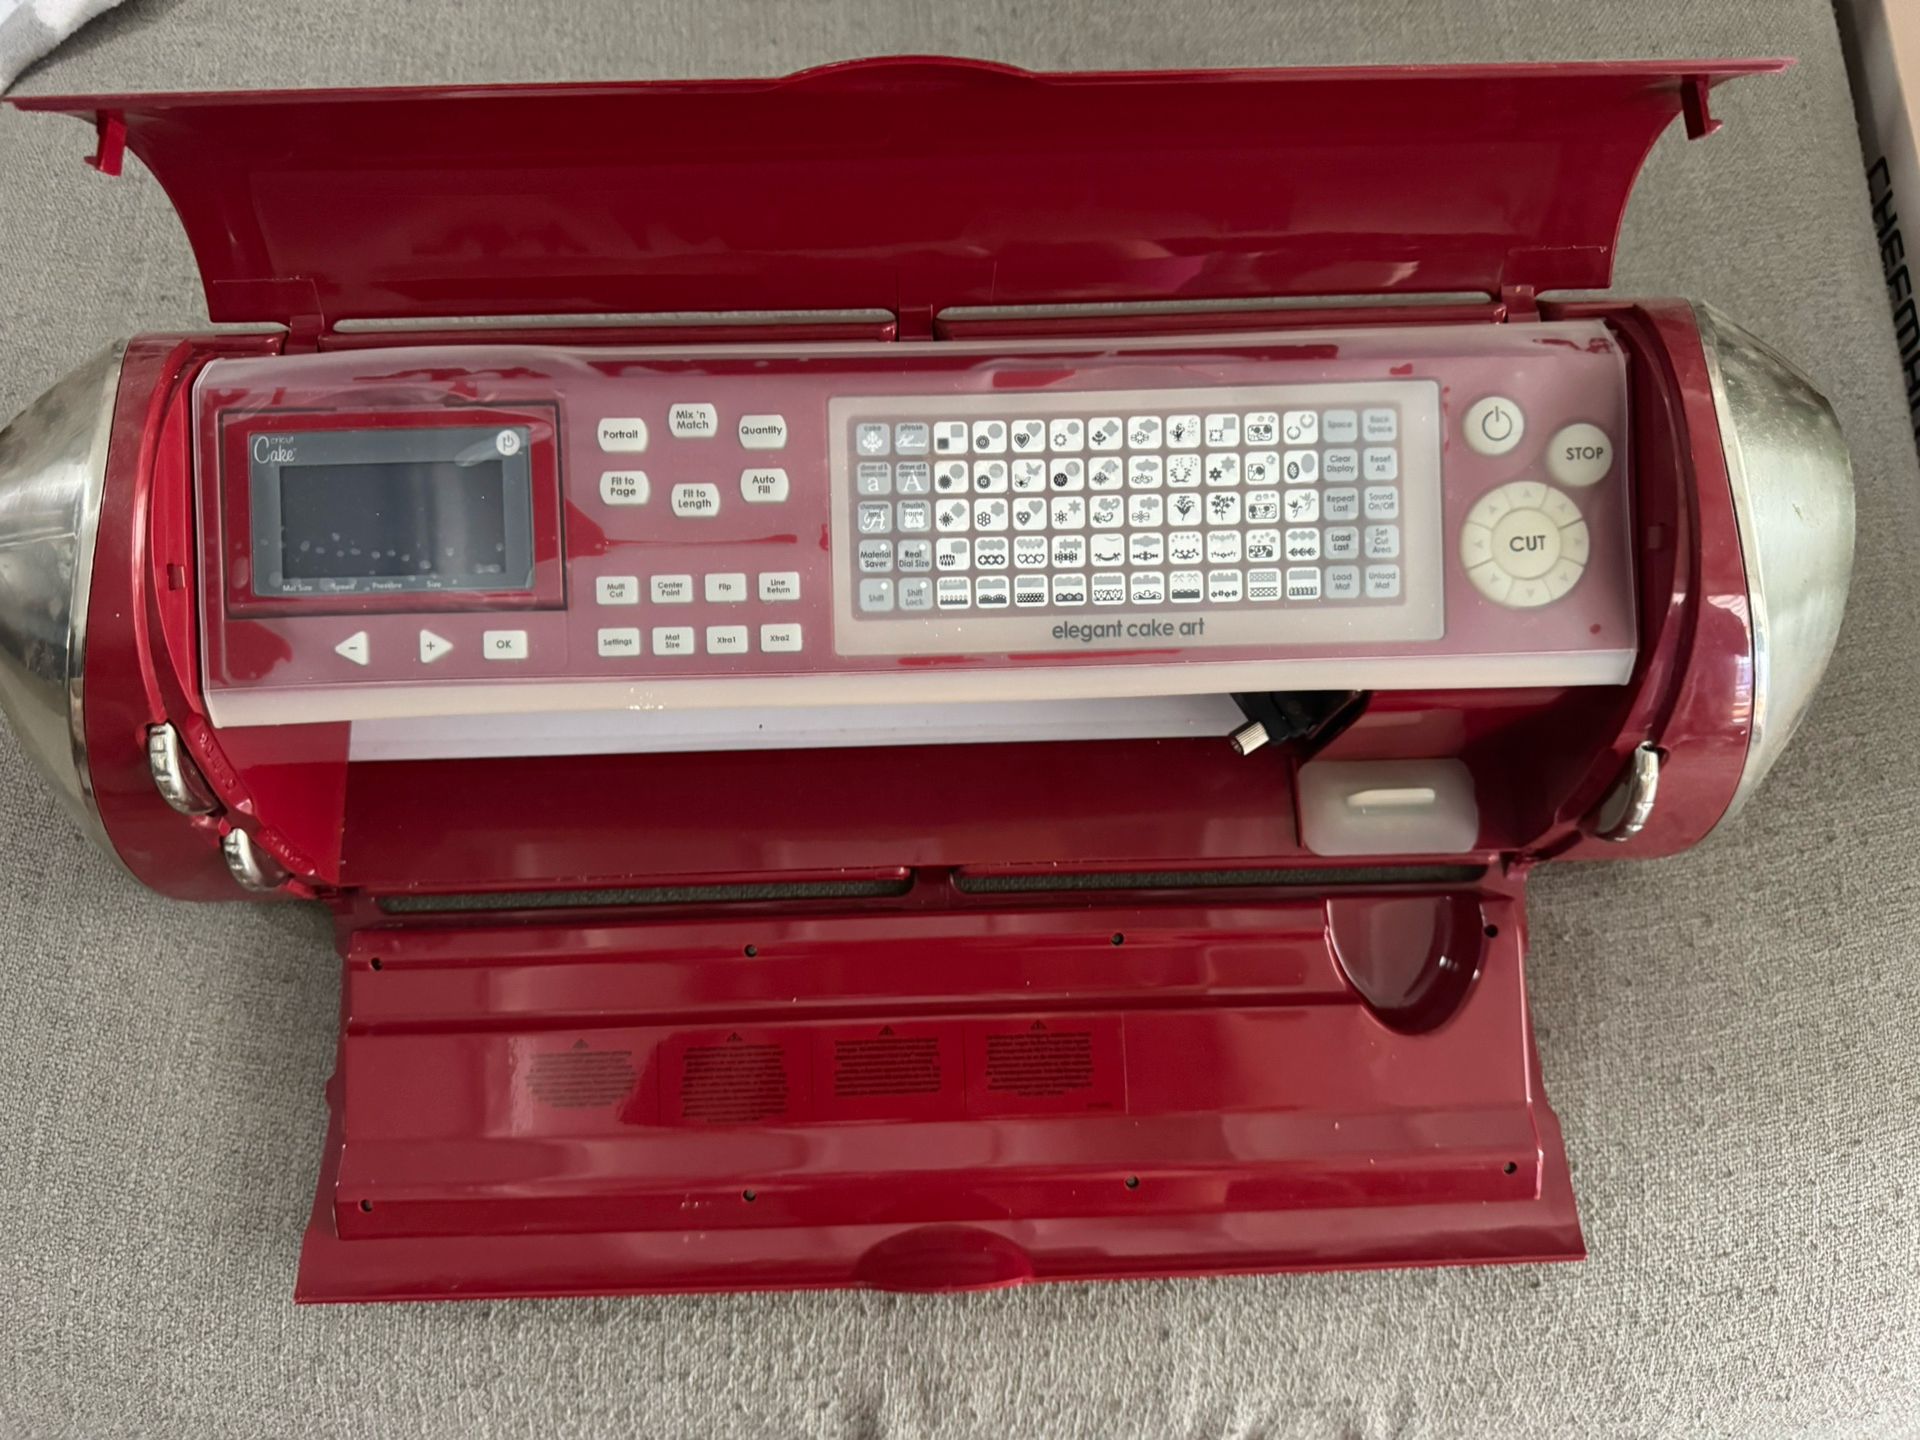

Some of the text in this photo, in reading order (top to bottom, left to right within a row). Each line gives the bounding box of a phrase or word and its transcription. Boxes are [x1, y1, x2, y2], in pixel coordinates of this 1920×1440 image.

[1868, 156, 1920, 440] CHEFMA
[676, 410, 693, 419] Mix
[677, 420, 709, 430] Match
[603, 430, 638, 439] Portrait
[741, 426, 782, 436] Quantity
[254, 435, 295, 464] Cake
[1566, 447, 1604, 461] STOP
[611, 477, 635, 485] Fit to
[752, 476, 775, 484] Auto
[610, 487, 636, 496] Page
[696, 489, 706, 497] to
[758, 486, 771, 494] Fill
[678, 499, 712, 510] Length
[1331, 534, 1351, 542] Load
[1509, 535, 1546, 552] CUT
[860, 550, 891, 559] Material
[905, 550, 922, 558] Real
[865, 560, 886, 568] Saver
[718, 583, 732, 591] Flip
[767, 586, 791, 594] Return
[1052, 617, 1204, 642] elegant cake art
[496, 639, 512, 649] OK
[603, 638, 632, 646] Settings
[665, 641, 680, 649] Size
